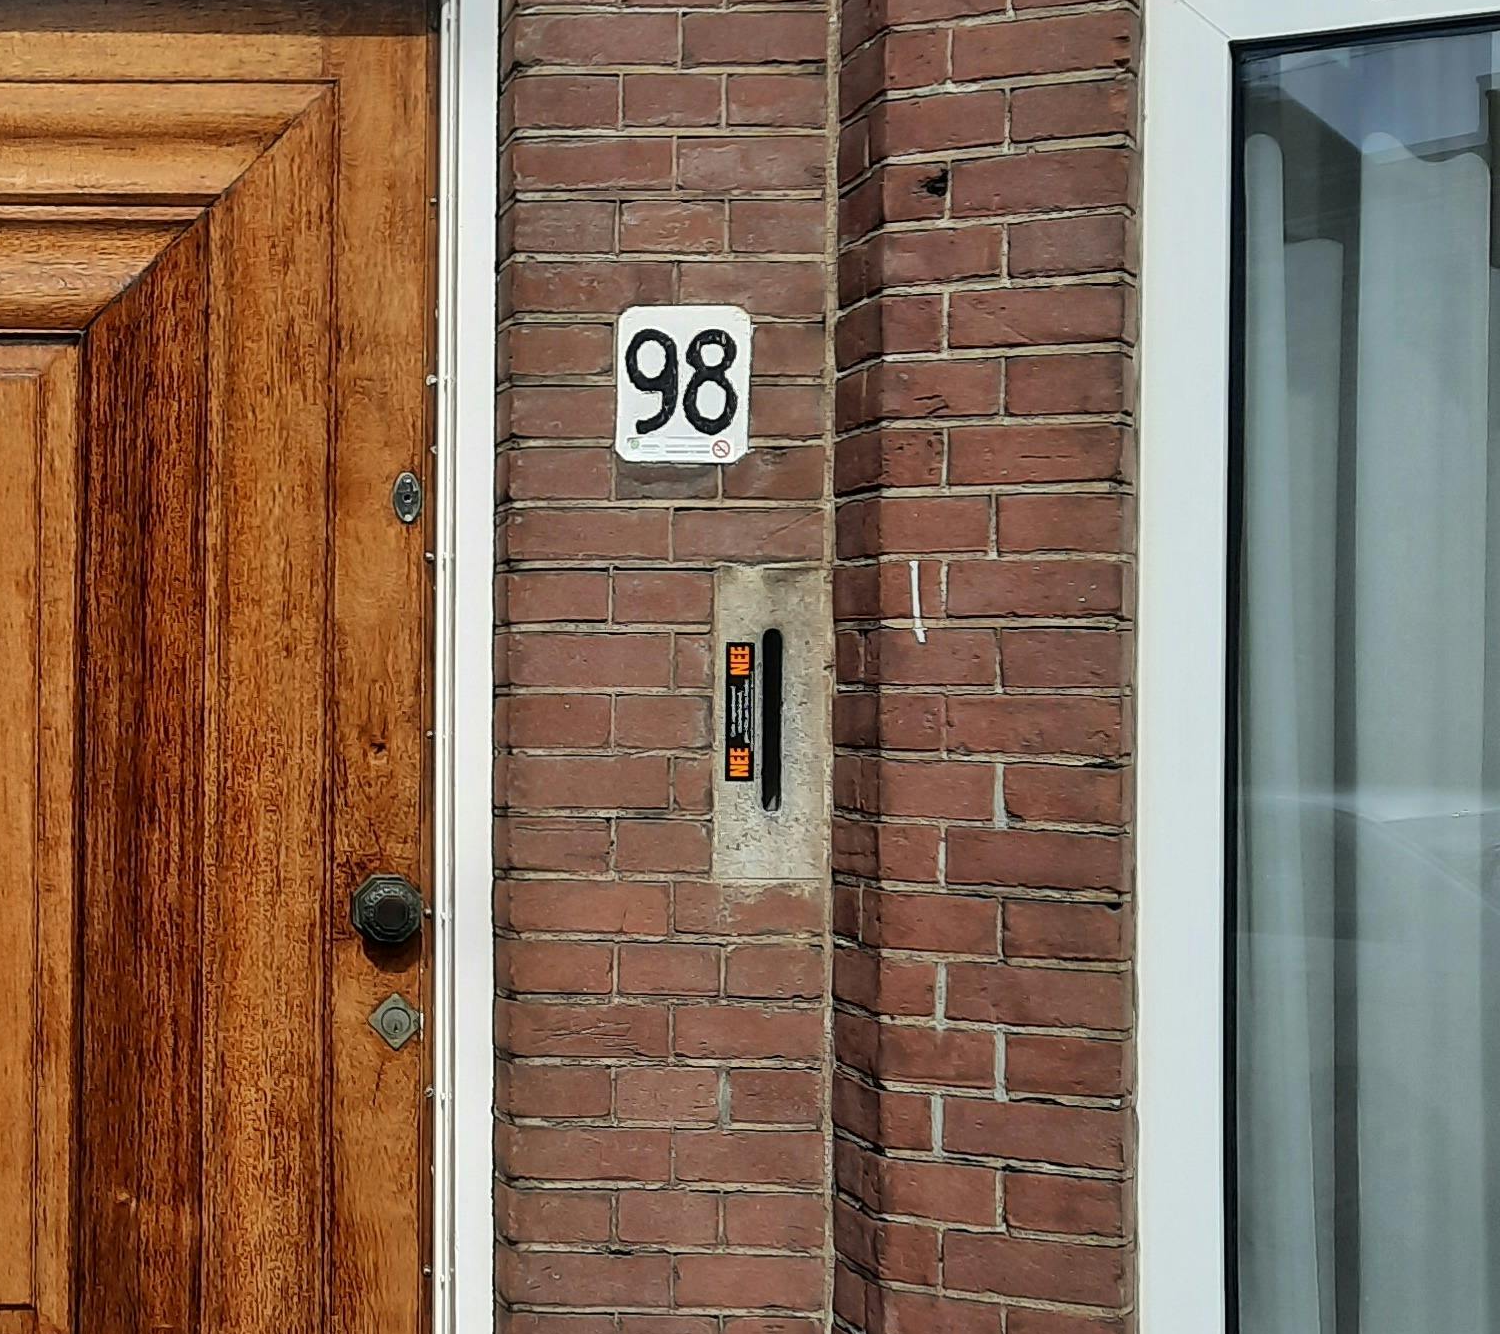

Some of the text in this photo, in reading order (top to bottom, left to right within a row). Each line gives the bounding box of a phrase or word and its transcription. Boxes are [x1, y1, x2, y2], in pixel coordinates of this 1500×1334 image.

[625, 328, 738, 435] 98
[729, 645, 750, 676] NEE
[729, 747, 750, 778] NEE
